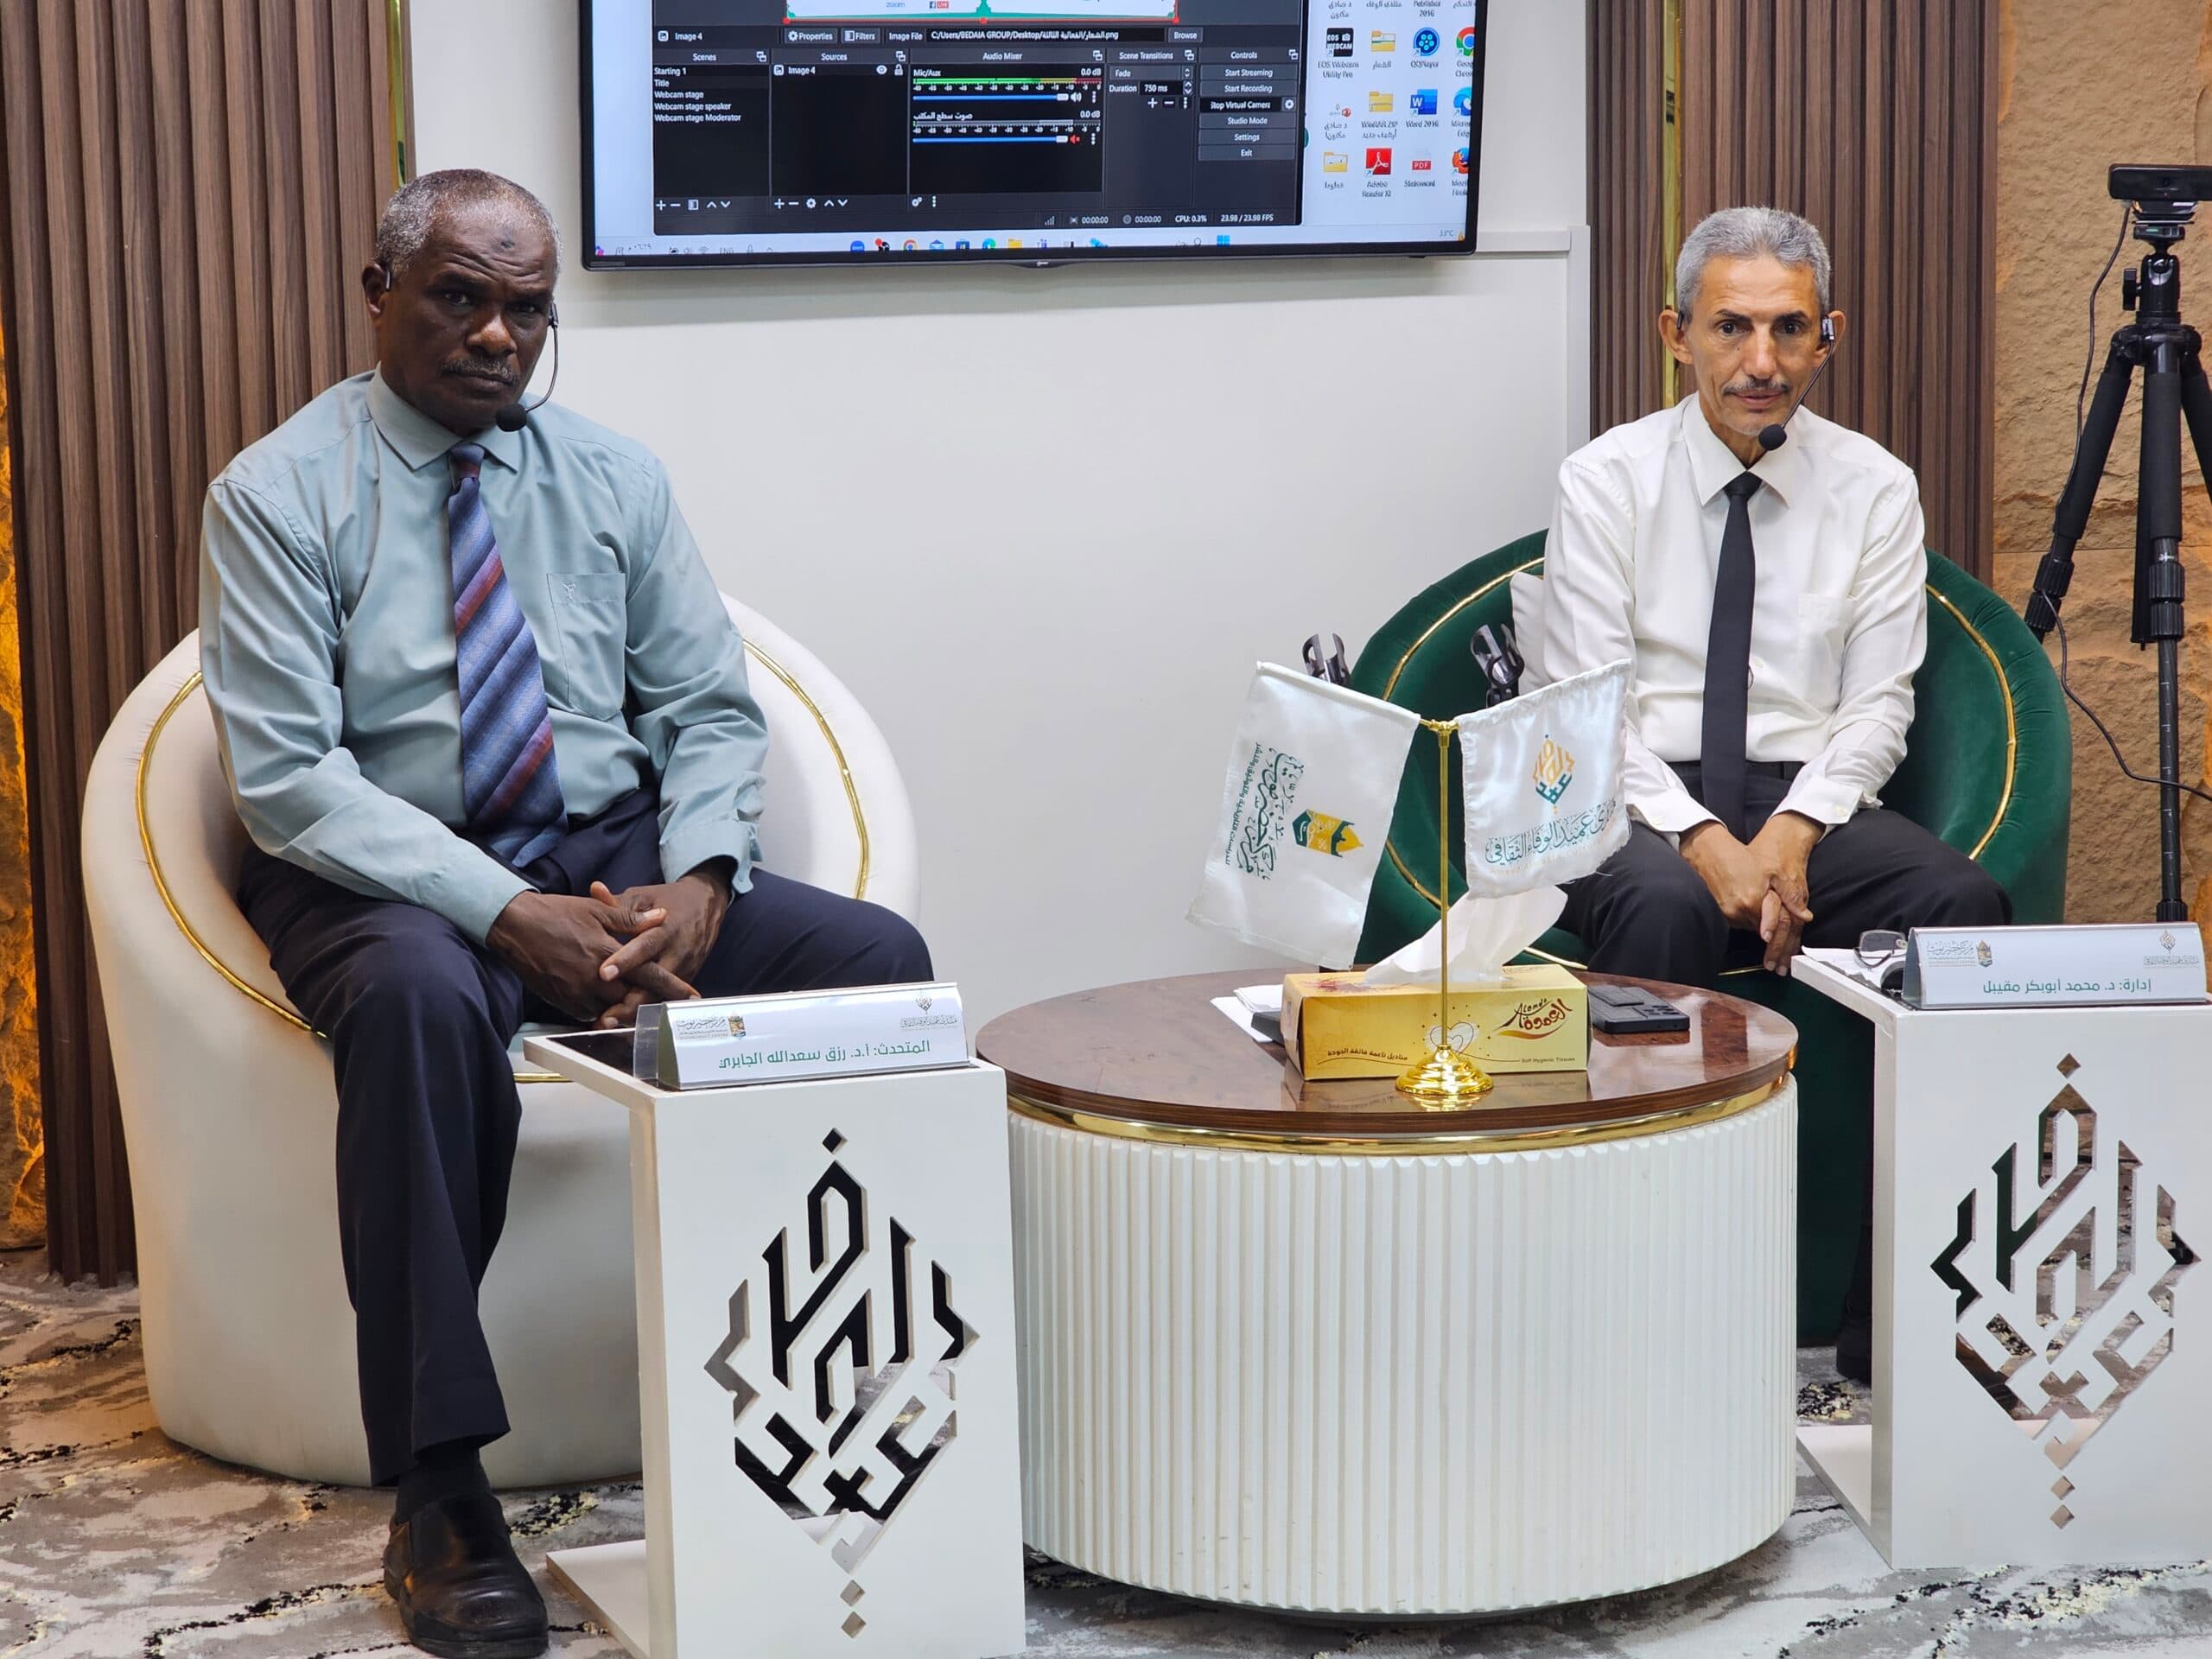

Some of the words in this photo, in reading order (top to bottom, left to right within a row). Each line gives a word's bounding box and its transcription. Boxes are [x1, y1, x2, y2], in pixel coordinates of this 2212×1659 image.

[675, 32, 697, 41] Image
[698, 32, 703, 41] 4
[798, 32, 833, 41] Properties
[855, 32, 875, 41] Filters
[889, 33, 910, 41] Image
[911, 32, 923, 41] File
[692, 53, 717, 61] Scenes
[821, 53, 848, 61] Sources
[982, 52, 1002, 60] Audio
[1004, 52, 1023, 60] Mixer
[1140, 51, 1173, 60] Transitions
[654, 67, 681, 76] Starting
[788, 67, 810, 75] Image
[1241, 69, 1273, 78] Streaming
[654, 79, 670, 87] Title
[1241, 85, 1273, 94] Recording
[684, 91, 704, 100] stage
[654, 102, 684, 111] Webcam
[684, 103, 704, 111] stage
[705, 102, 732, 111] speaker
[654, 113, 684, 122] Webcam
[684, 114, 704, 123] stage
[705, 113, 741, 122] Moderator
[1227, 117, 1247, 125] Studio
[1234, 133, 1260, 143] Settings
[1082, 216, 1109, 225] 00:00:00
[1135, 215, 1161, 224] 00:00:00
[1175, 214, 1192, 223] CPU:
[1243, 213, 1261, 222] 23.98
[1262, 213, 1274, 222] FPS
[1983, 980, 2020, 995] مقيبل
[2024, 979, 2061, 994] أبوبكر
[2065, 981, 2101, 992] محمد
[2104, 981, 2115, 990] د.
[2120, 978, 2152, 992] إدارة:
[1524, 998, 1573, 1030] العمدة
[873, 1039, 931, 1057] المتحدث:
[1327, 1047, 1349, 1057] الجودة
[1350, 1047, 1368, 1056] فائقة
[767, 1050, 821, 1064] سعدالله
[825, 1046, 846, 1062] رزق
[1369, 1050, 1386, 1058] ناعمة
[1387, 1052, 1408, 1061] مناديل
[719, 1052, 762, 1069] الجابري
